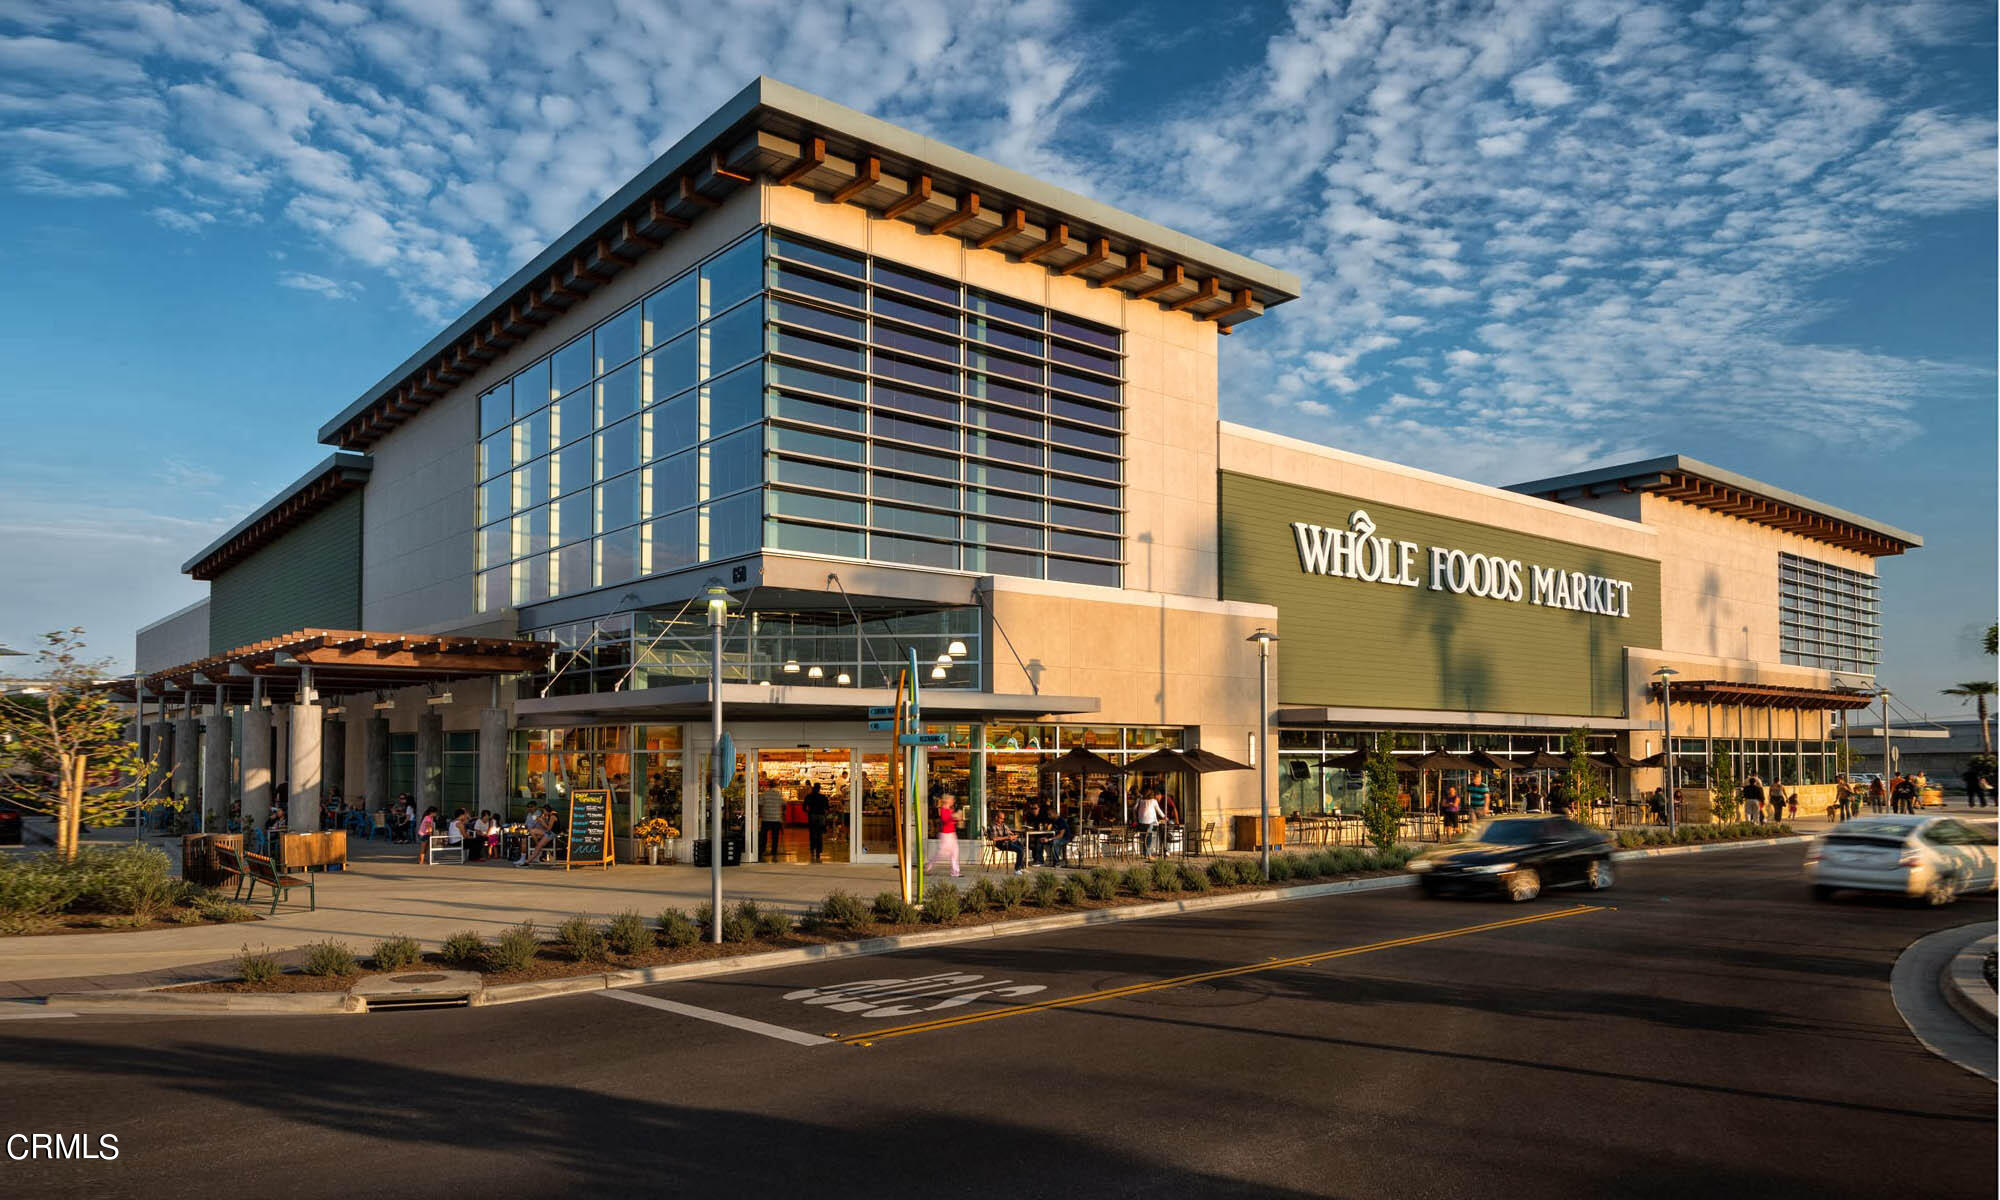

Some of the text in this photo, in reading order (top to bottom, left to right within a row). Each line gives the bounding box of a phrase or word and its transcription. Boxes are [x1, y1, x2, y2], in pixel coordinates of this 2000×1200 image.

[1290, 511, 1634, 619] WHOLE FOODS MARKET
